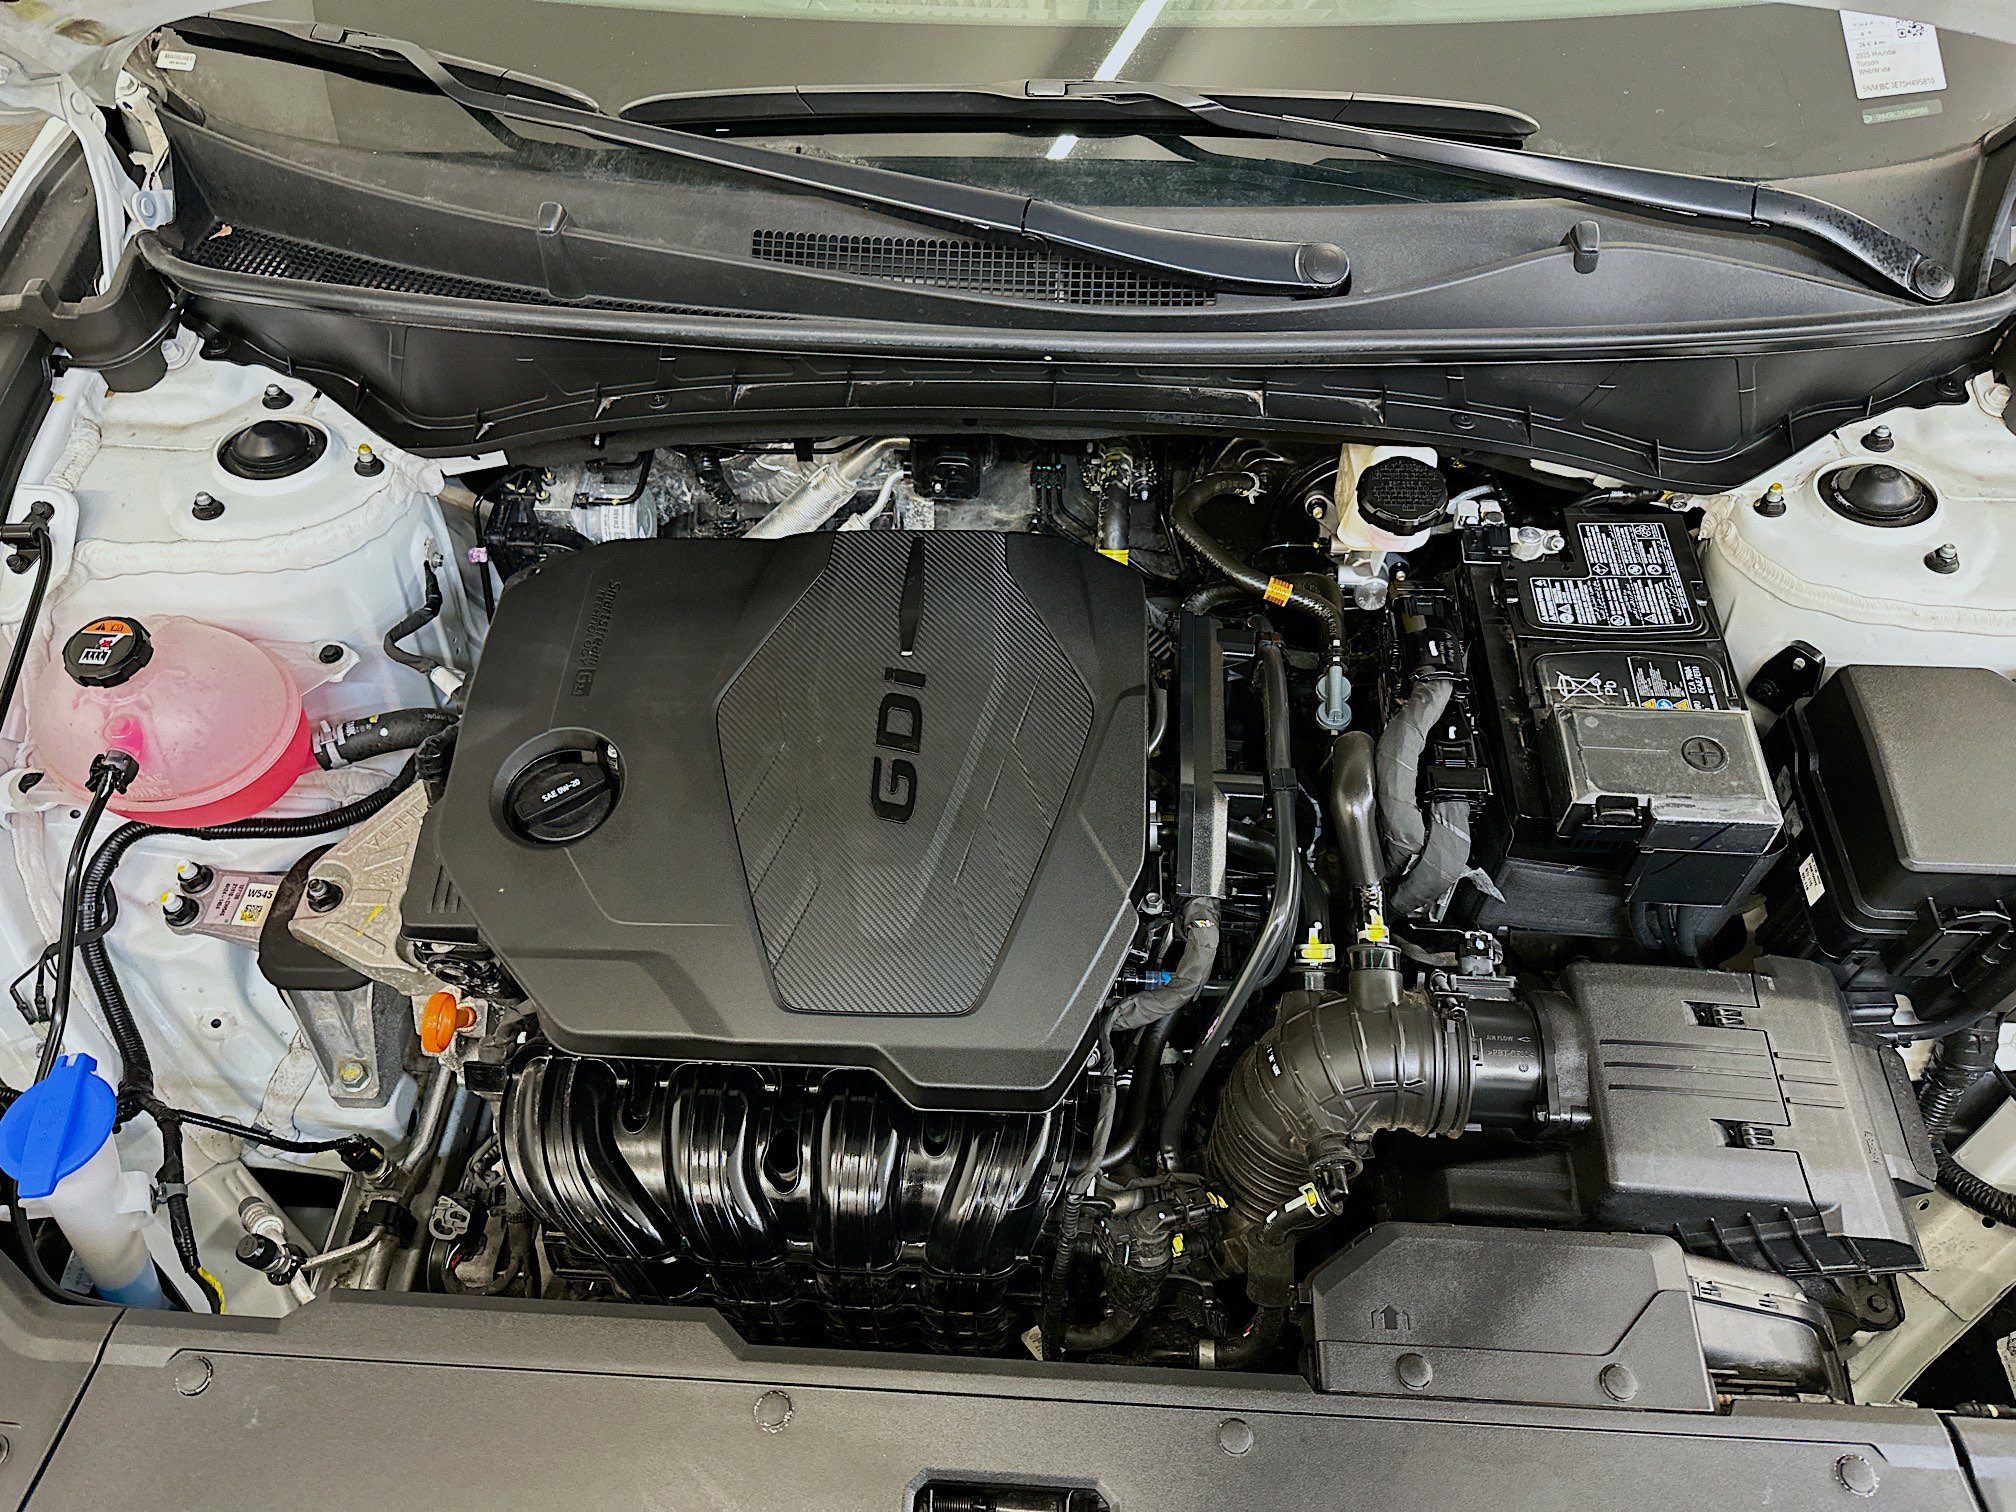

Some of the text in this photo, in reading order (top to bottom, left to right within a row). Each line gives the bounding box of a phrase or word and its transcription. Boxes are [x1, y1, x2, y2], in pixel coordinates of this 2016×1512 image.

[588, 580, 621, 666] Smartstream
[1604, 680, 1619, 696] Pb
[541, 778, 582, 803] SAE 0W-20
[247, 888, 274, 899] W545
